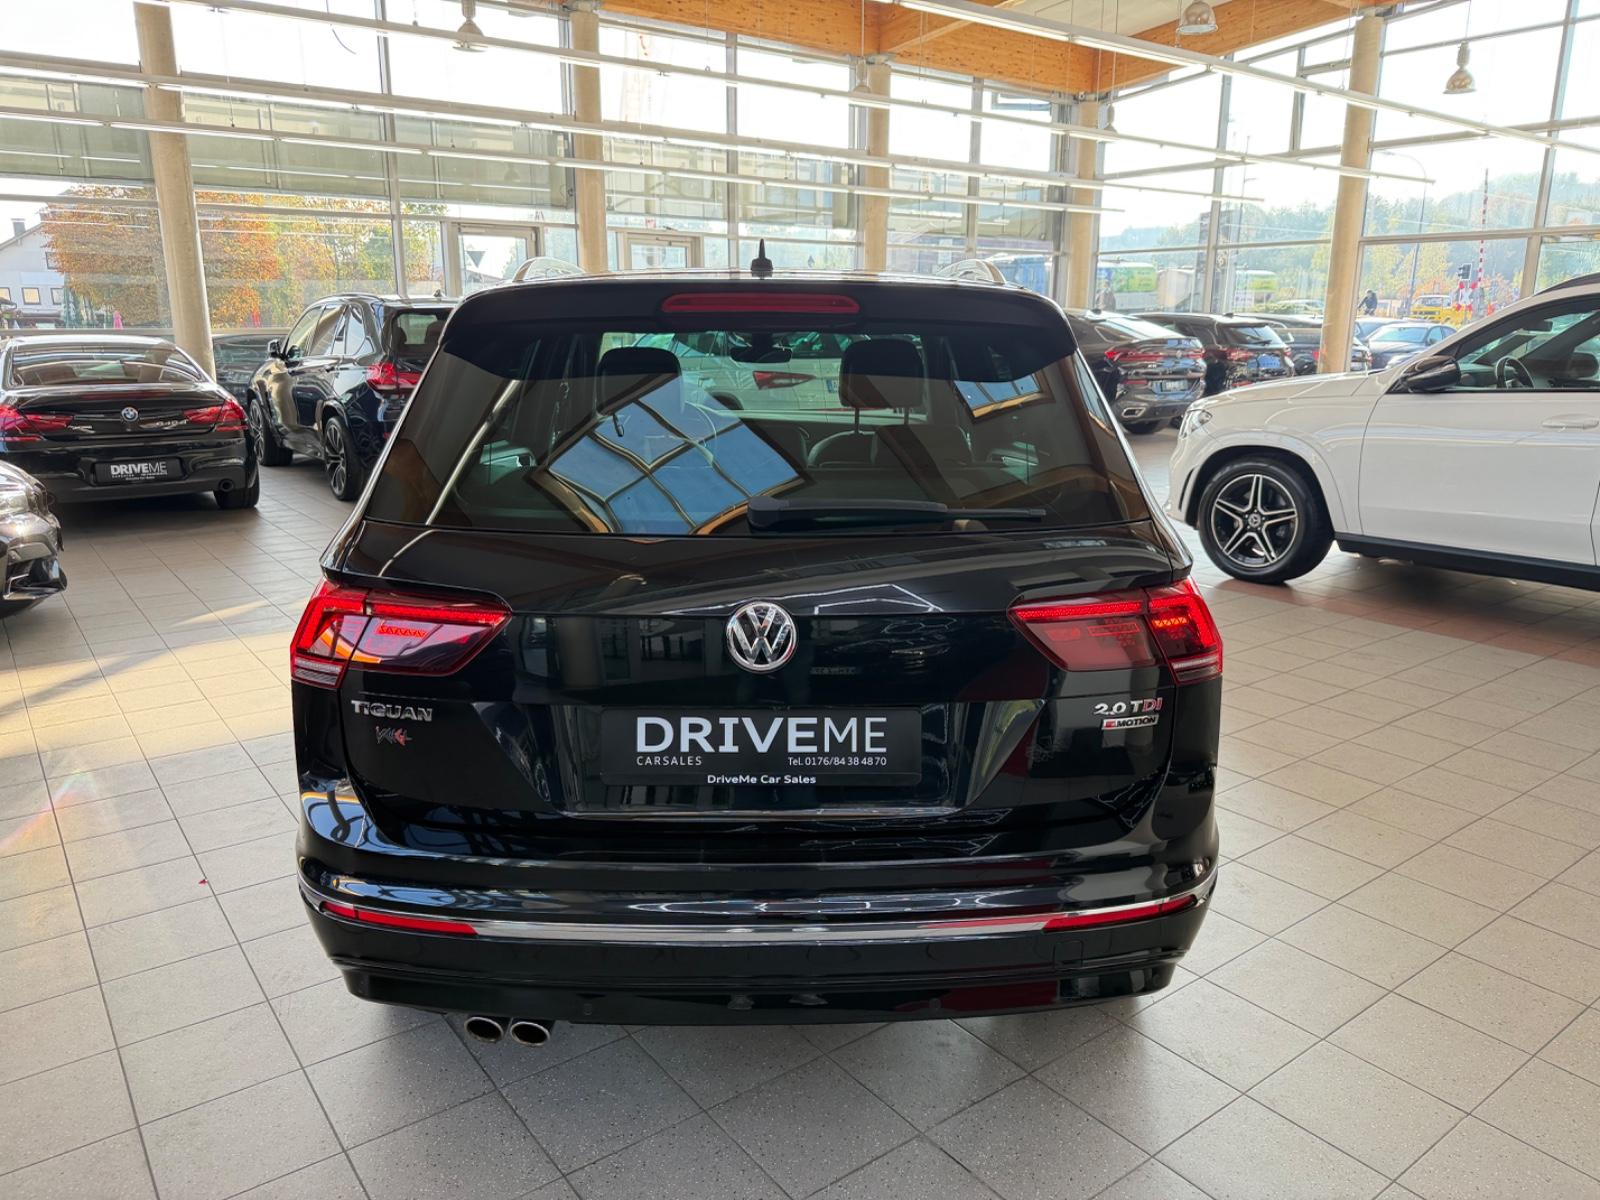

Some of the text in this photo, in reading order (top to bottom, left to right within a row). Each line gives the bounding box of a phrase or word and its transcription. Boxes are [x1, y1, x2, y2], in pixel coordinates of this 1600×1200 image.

[110, 461, 168, 475] DRIVEME
[351, 700, 433, 722] TIGUAN
[1094, 697, 1163, 716] 2.0 TDI
[636, 716, 888, 753] DRIVEME
[636, 755, 703, 766] CARSALES
[707, 774, 816, 784] DriveMe Car Sales
